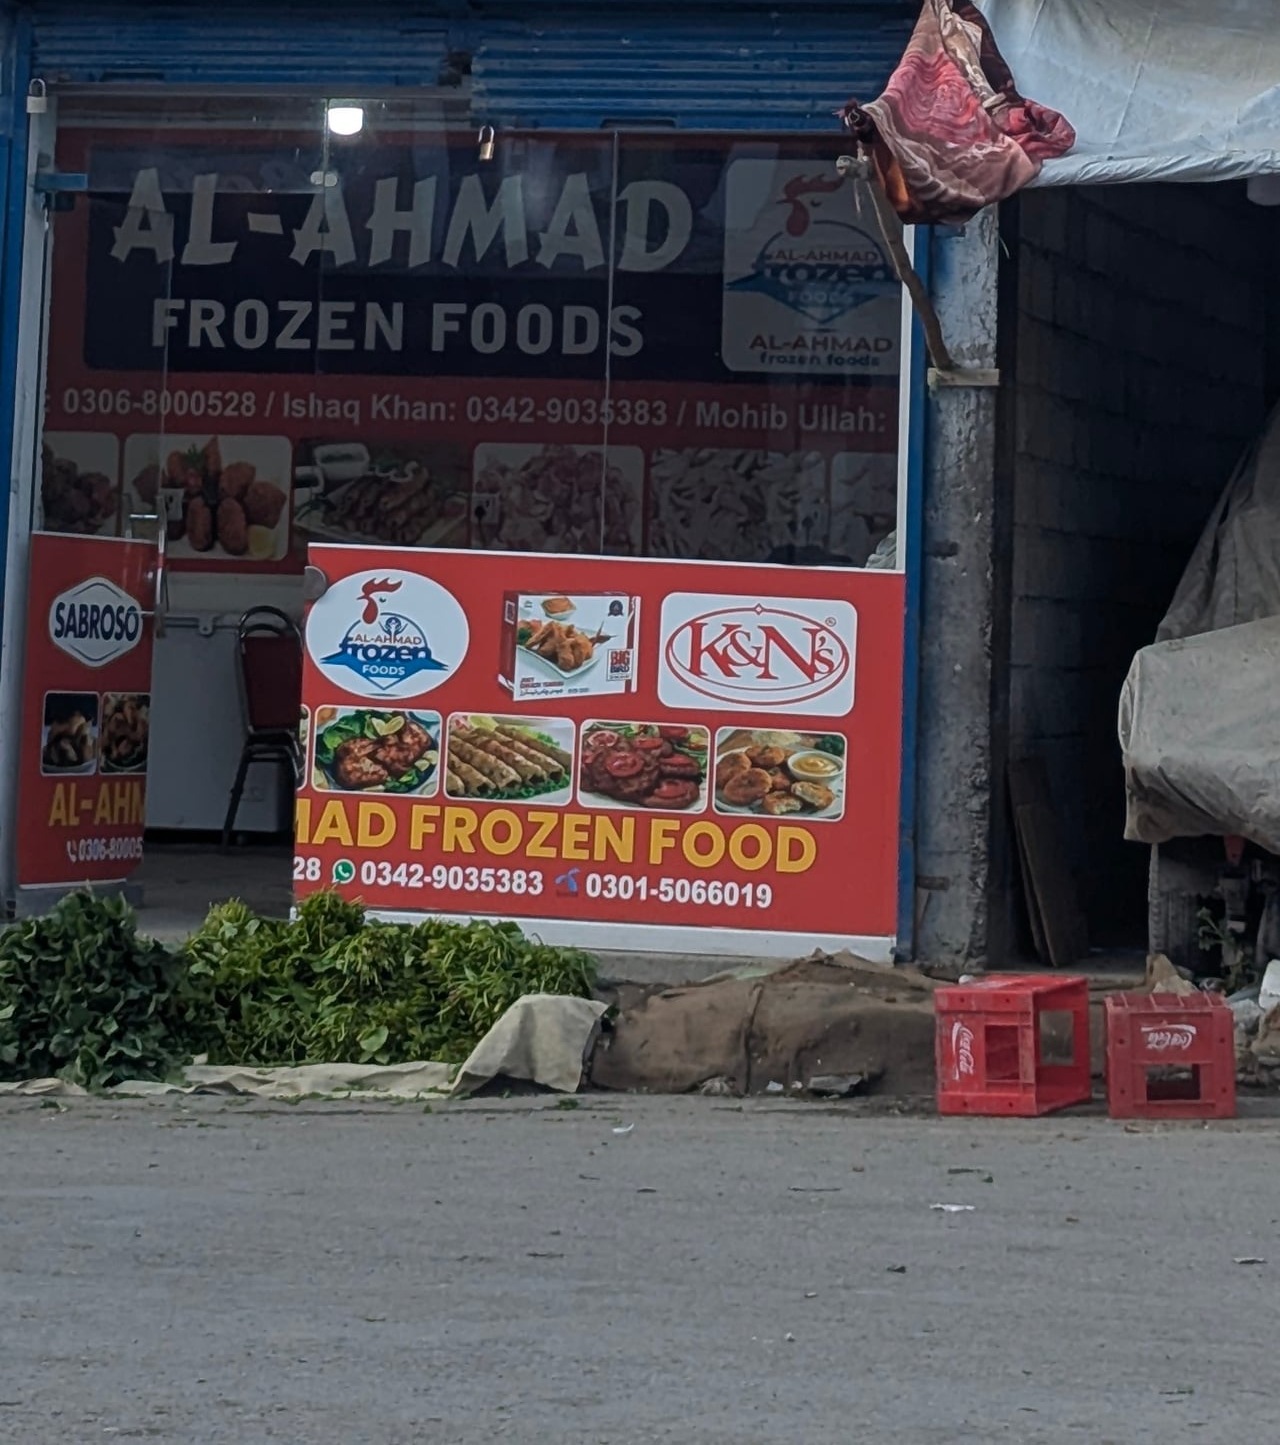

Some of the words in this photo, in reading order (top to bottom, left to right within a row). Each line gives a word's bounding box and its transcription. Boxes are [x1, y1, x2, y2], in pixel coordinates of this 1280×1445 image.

[110, 167, 694, 273] AL-AHMAD
[775, 249, 879, 263] AL-AHMAD
[151, 298, 404, 351] FROZEN
[431, 301, 644, 357] FOODS
[750, 334, 894, 353] AL-AHMAD
[63, 387, 257, 417] 0306-8000528
[283, 391, 361, 424] Ishaq
[371, 394, 456, 422] Khan:
[466, 395, 668, 427] 0342-9035383
[695, 400, 788, 430] Mohib
[798, 402, 887, 433] Ullah:
[54, 601, 139, 642] SABROSO
[354, 634, 423, 645] AL-AHMAD
[362, 664, 406, 677] FOODS
[410, 804, 635, 863] FROZEN
[649, 819, 817, 874] FOOD
[360, 860, 545, 896] 0342-9035383
[586, 873, 773, 909] 0301-5066019
